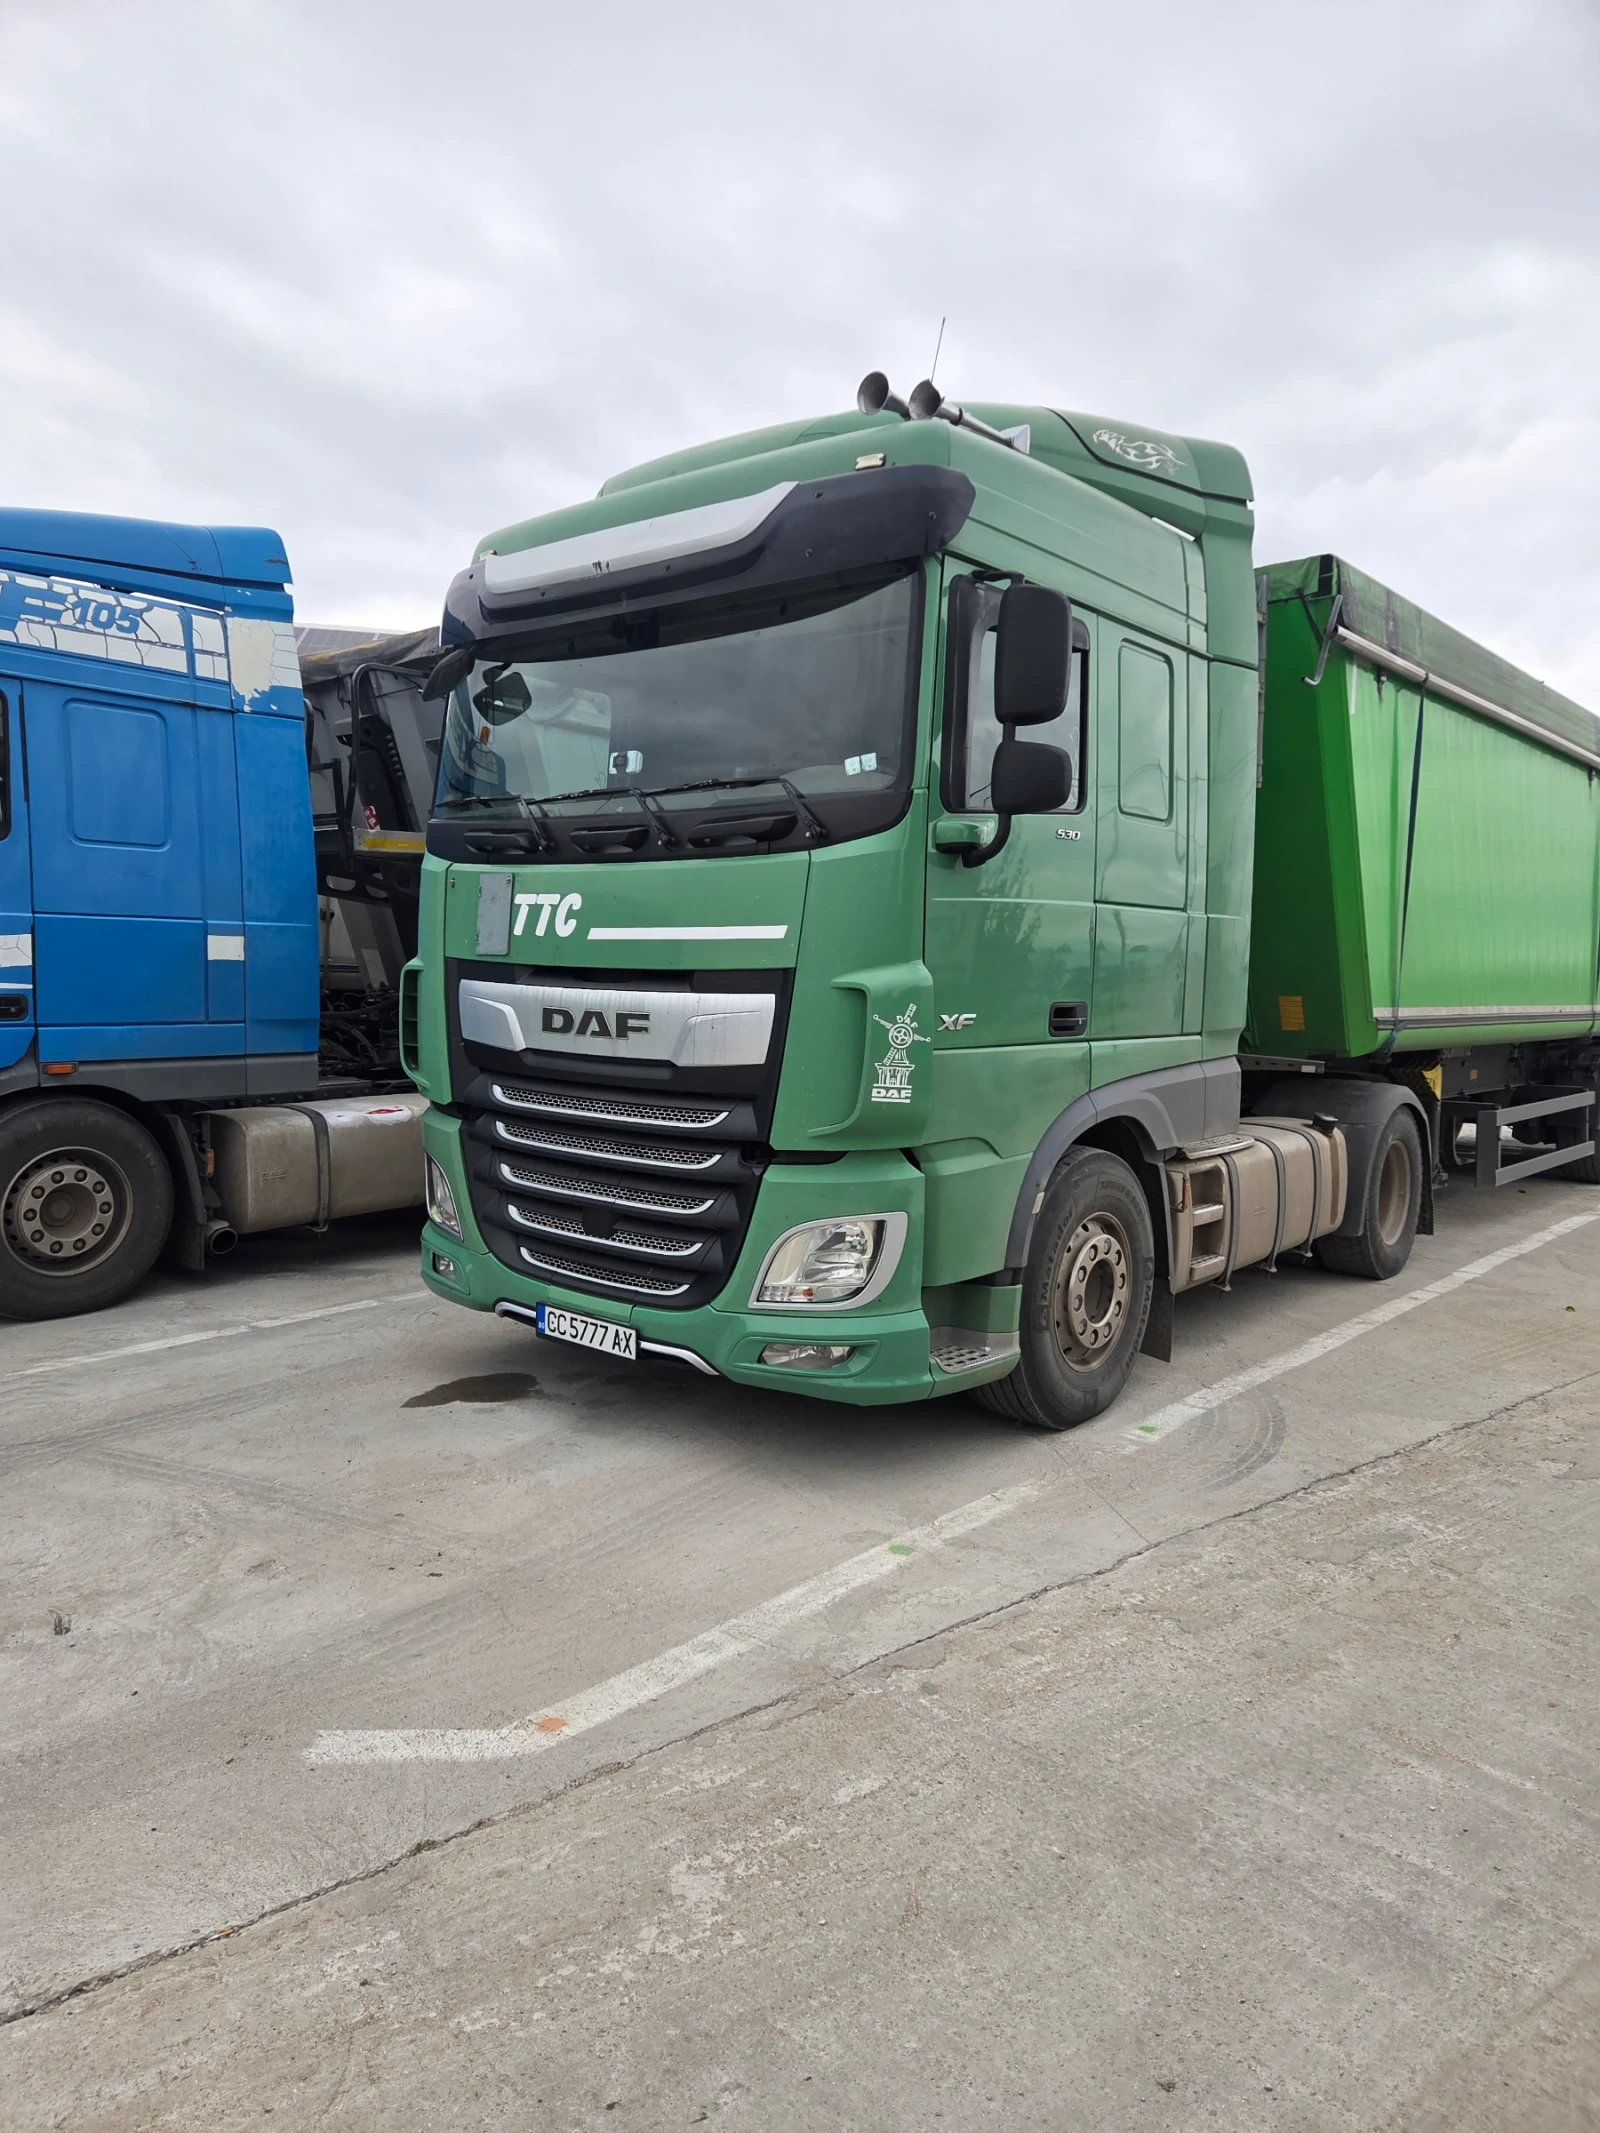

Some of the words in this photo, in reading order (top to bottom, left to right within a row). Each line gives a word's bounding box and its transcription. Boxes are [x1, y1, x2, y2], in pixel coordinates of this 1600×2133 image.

[72, 598, 141, 634] 105
[1056, 829, 1080, 840] 530
[513, 893, 582, 937] TTC
[541, 1006, 650, 1040] DAF
[937, 1013, 977, 1031] XF
[871, 1088, 912, 1098] DAF
[1040, 1207, 1073, 1303] Matador
[612, 1328, 632, 1355] AX
